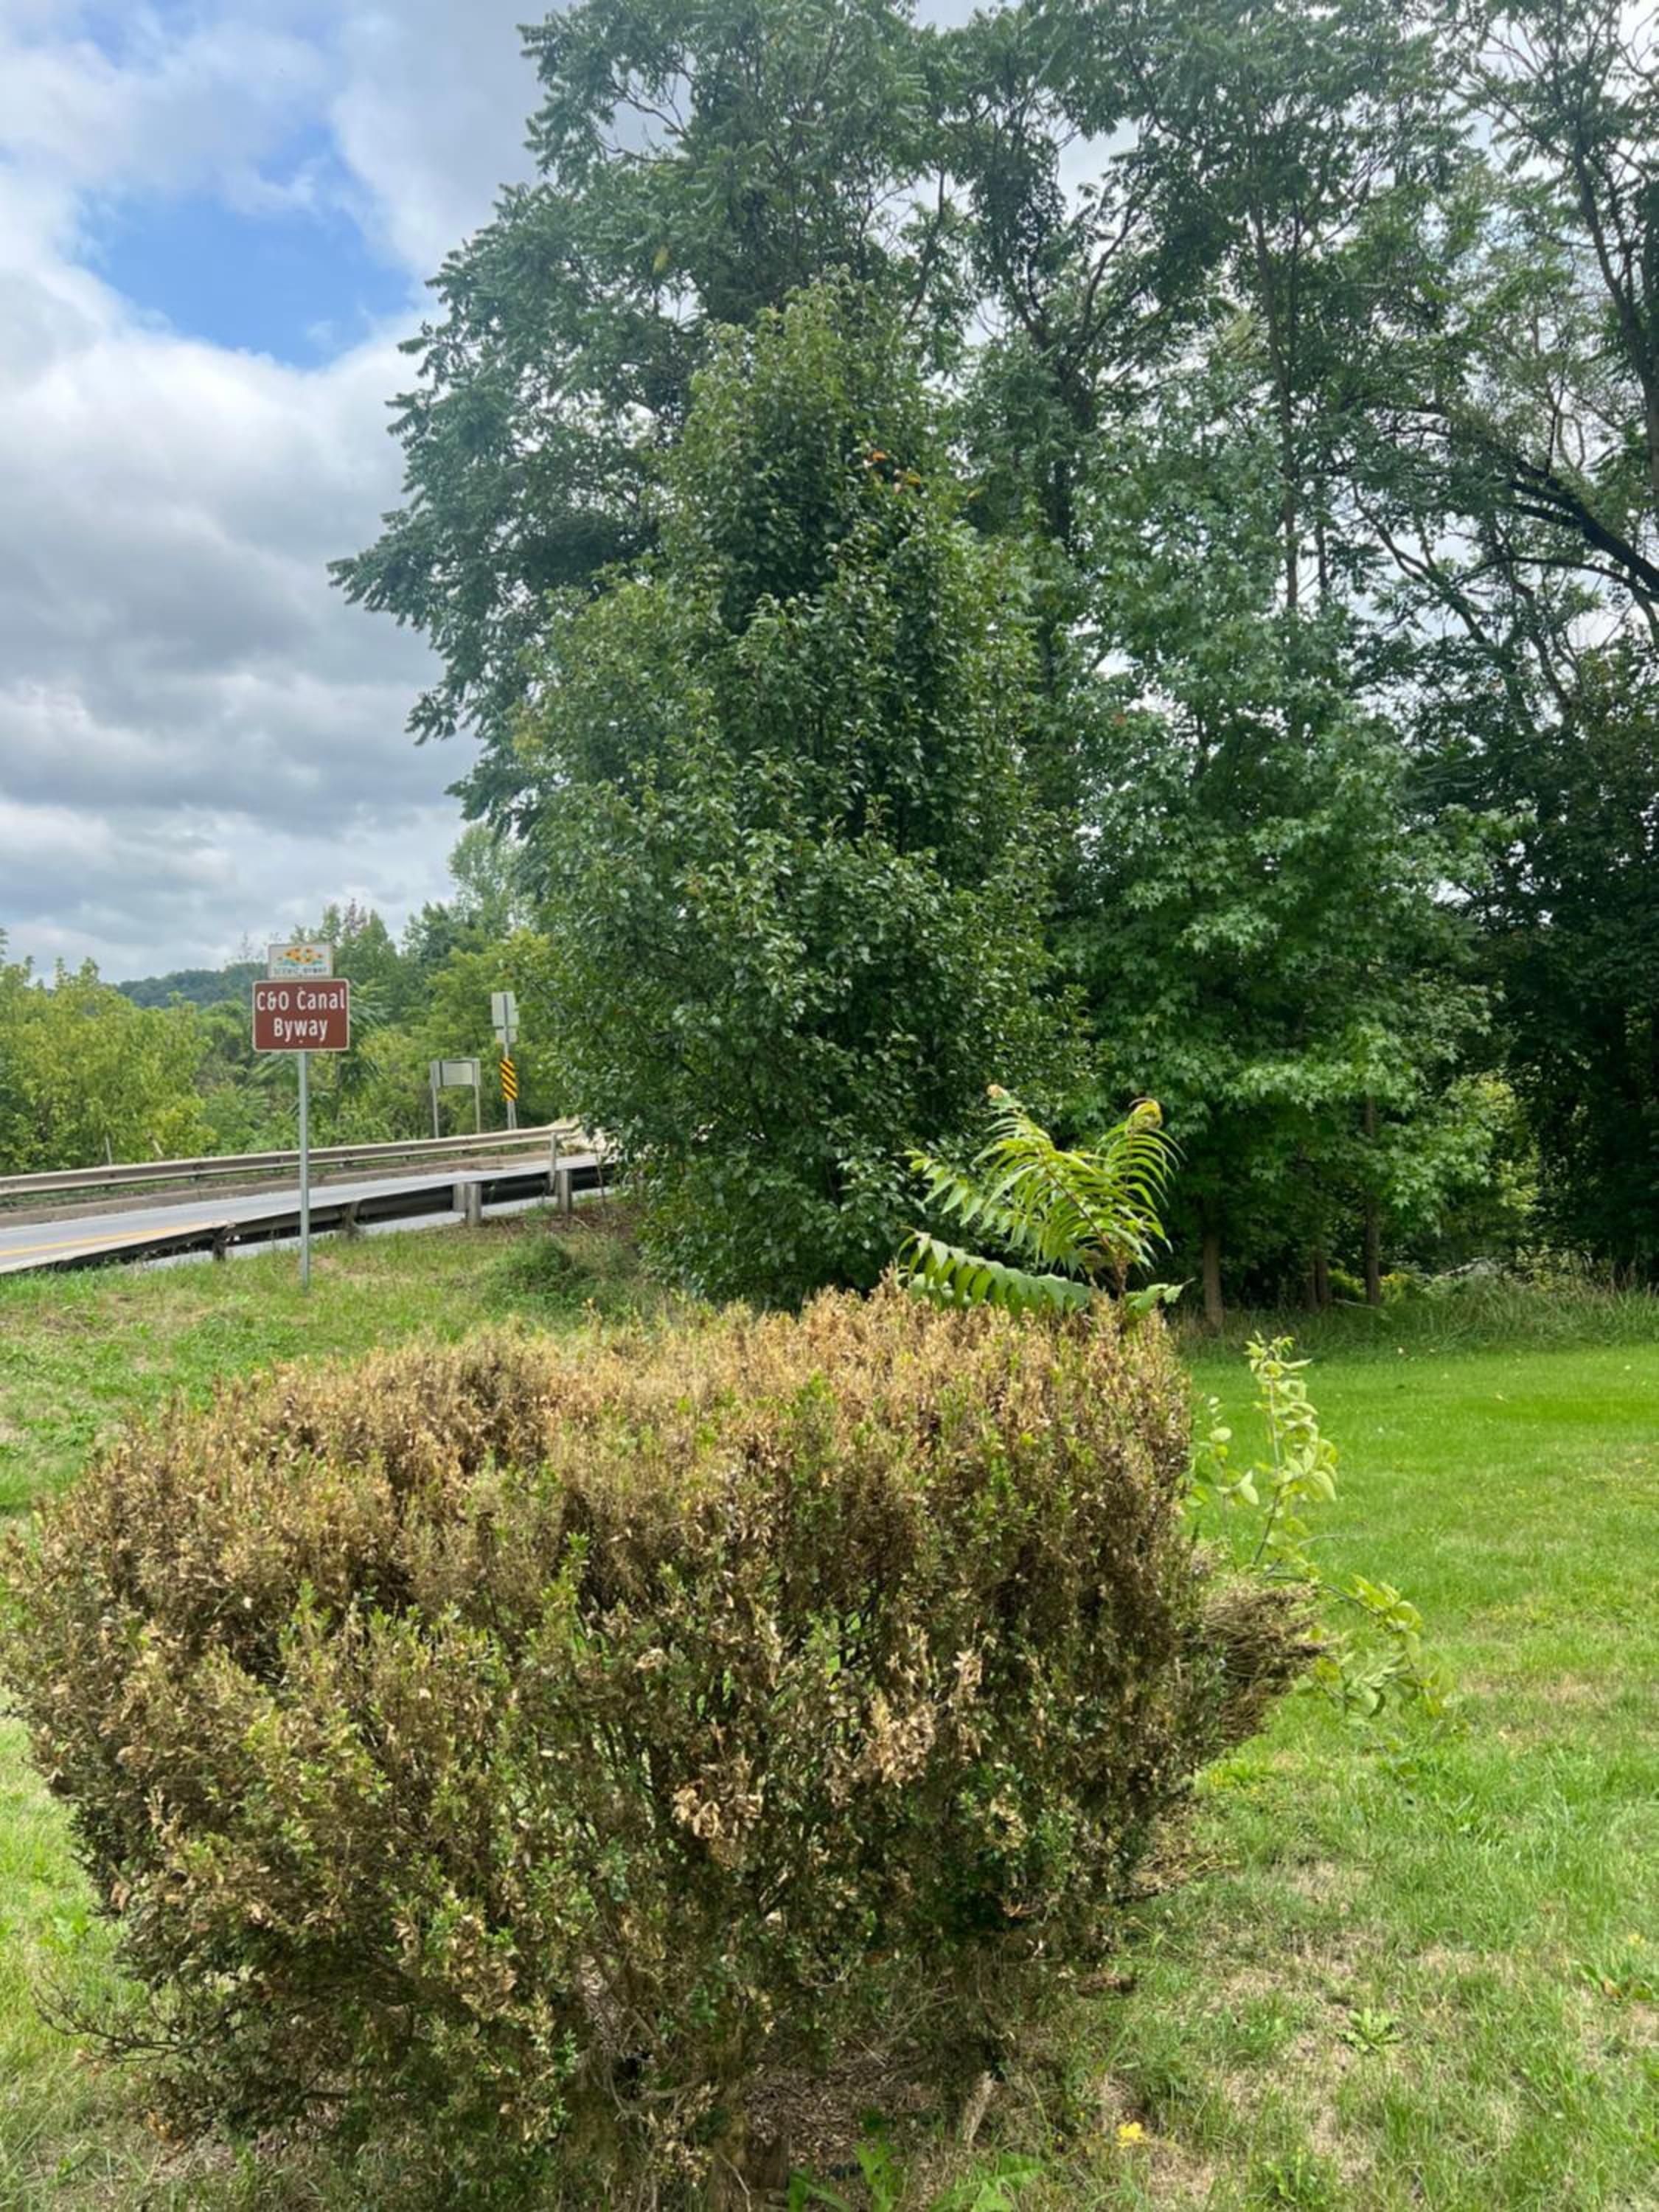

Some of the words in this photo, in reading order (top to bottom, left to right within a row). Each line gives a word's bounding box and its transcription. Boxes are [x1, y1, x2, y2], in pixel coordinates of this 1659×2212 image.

[257, 991, 290, 1011] C&O
[296, 989, 345, 1010] Canal
[274, 1018, 327, 1042] Byway
